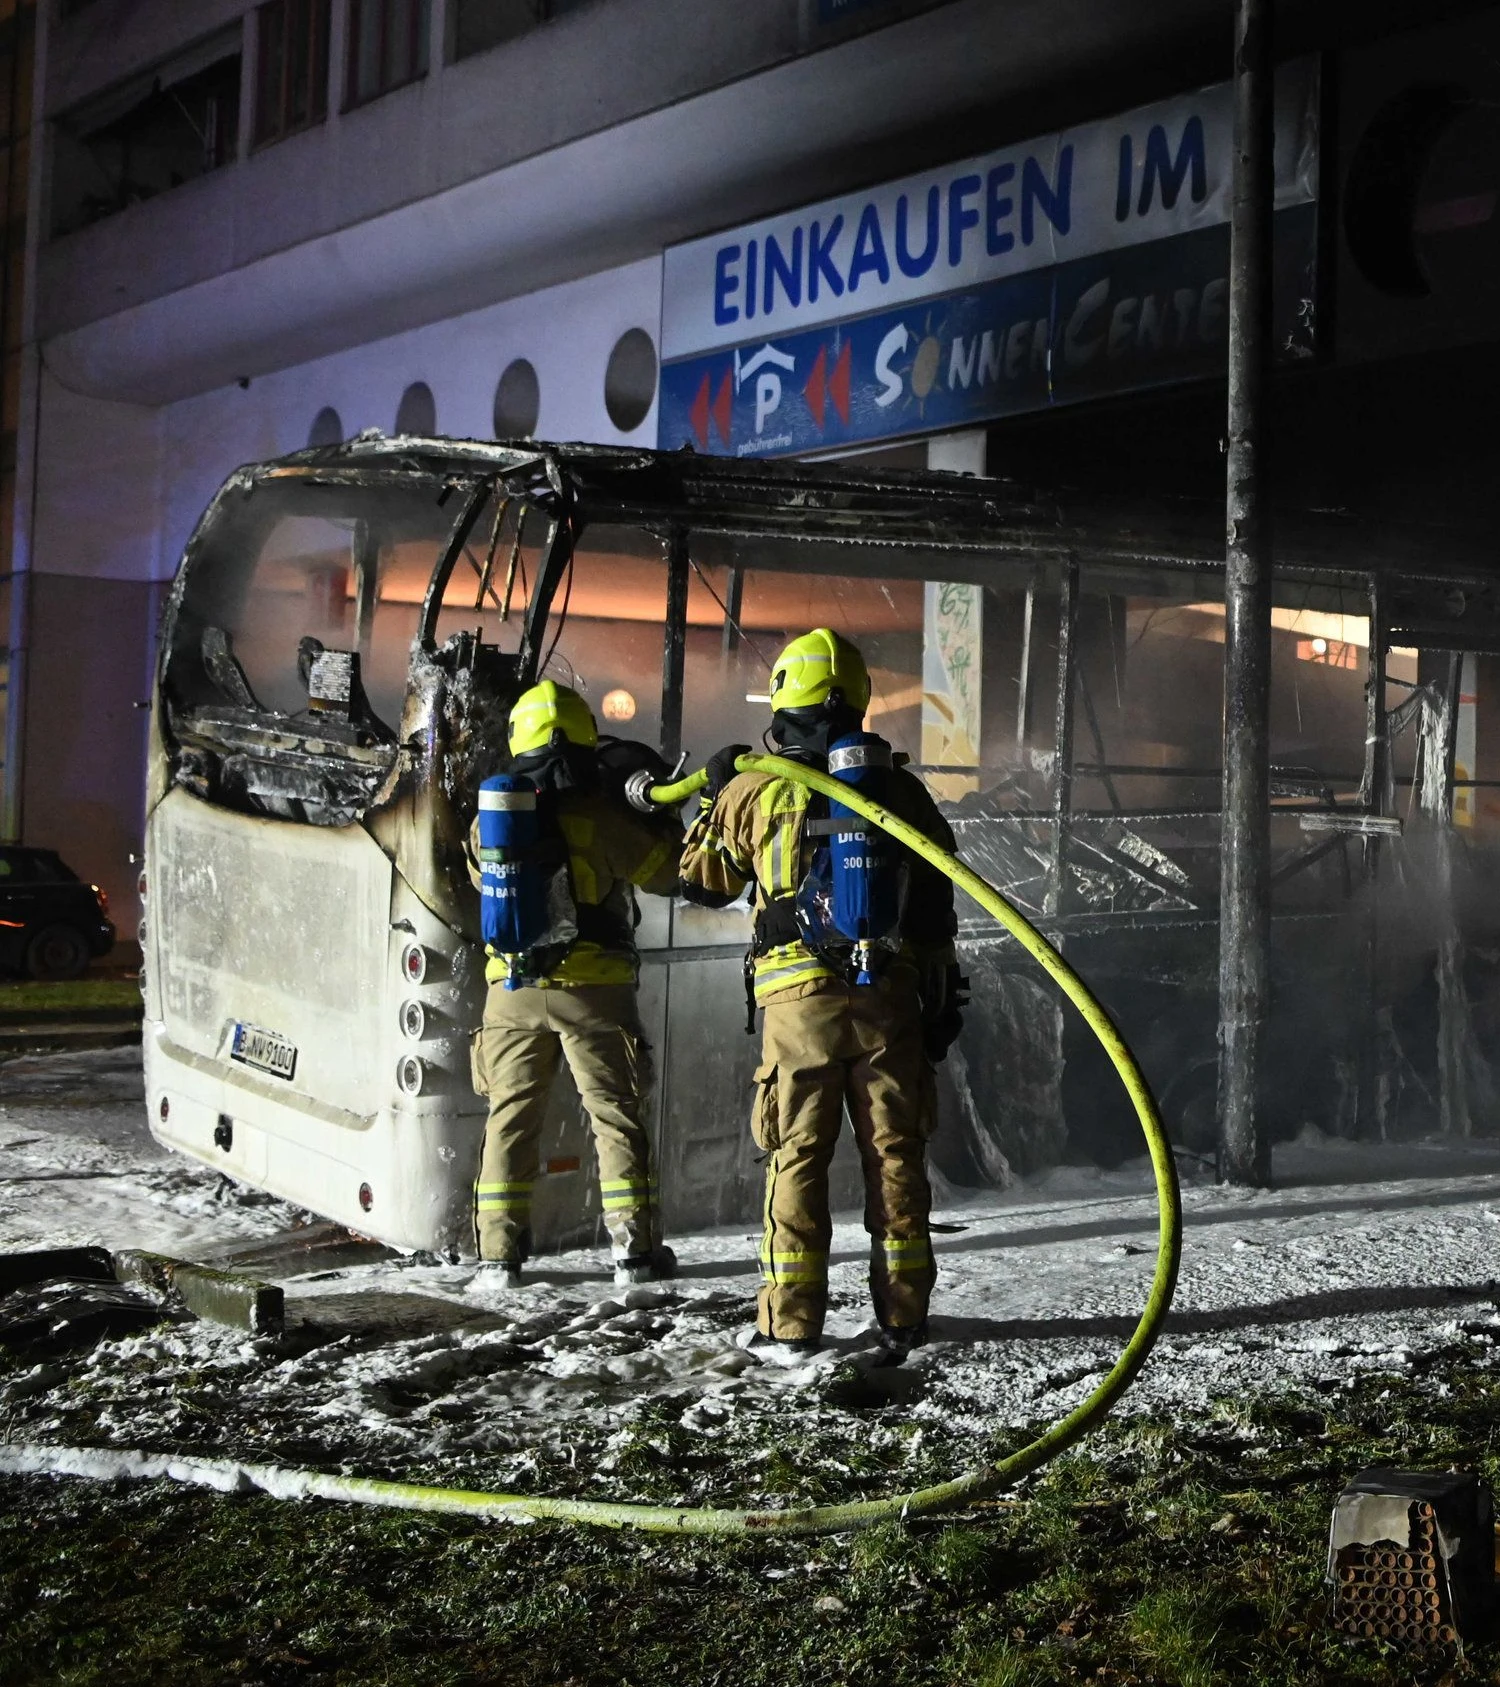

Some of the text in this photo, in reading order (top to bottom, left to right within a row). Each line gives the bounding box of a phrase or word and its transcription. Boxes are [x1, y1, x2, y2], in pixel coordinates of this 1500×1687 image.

[713, 115, 1207, 327] EINKAUFEN IM
[755, 373, 782, 435] P
[843, 856, 863, 870] 300
[496, 887, 517, 899] BAR
[265, 1040, 293, 1071] 9100
